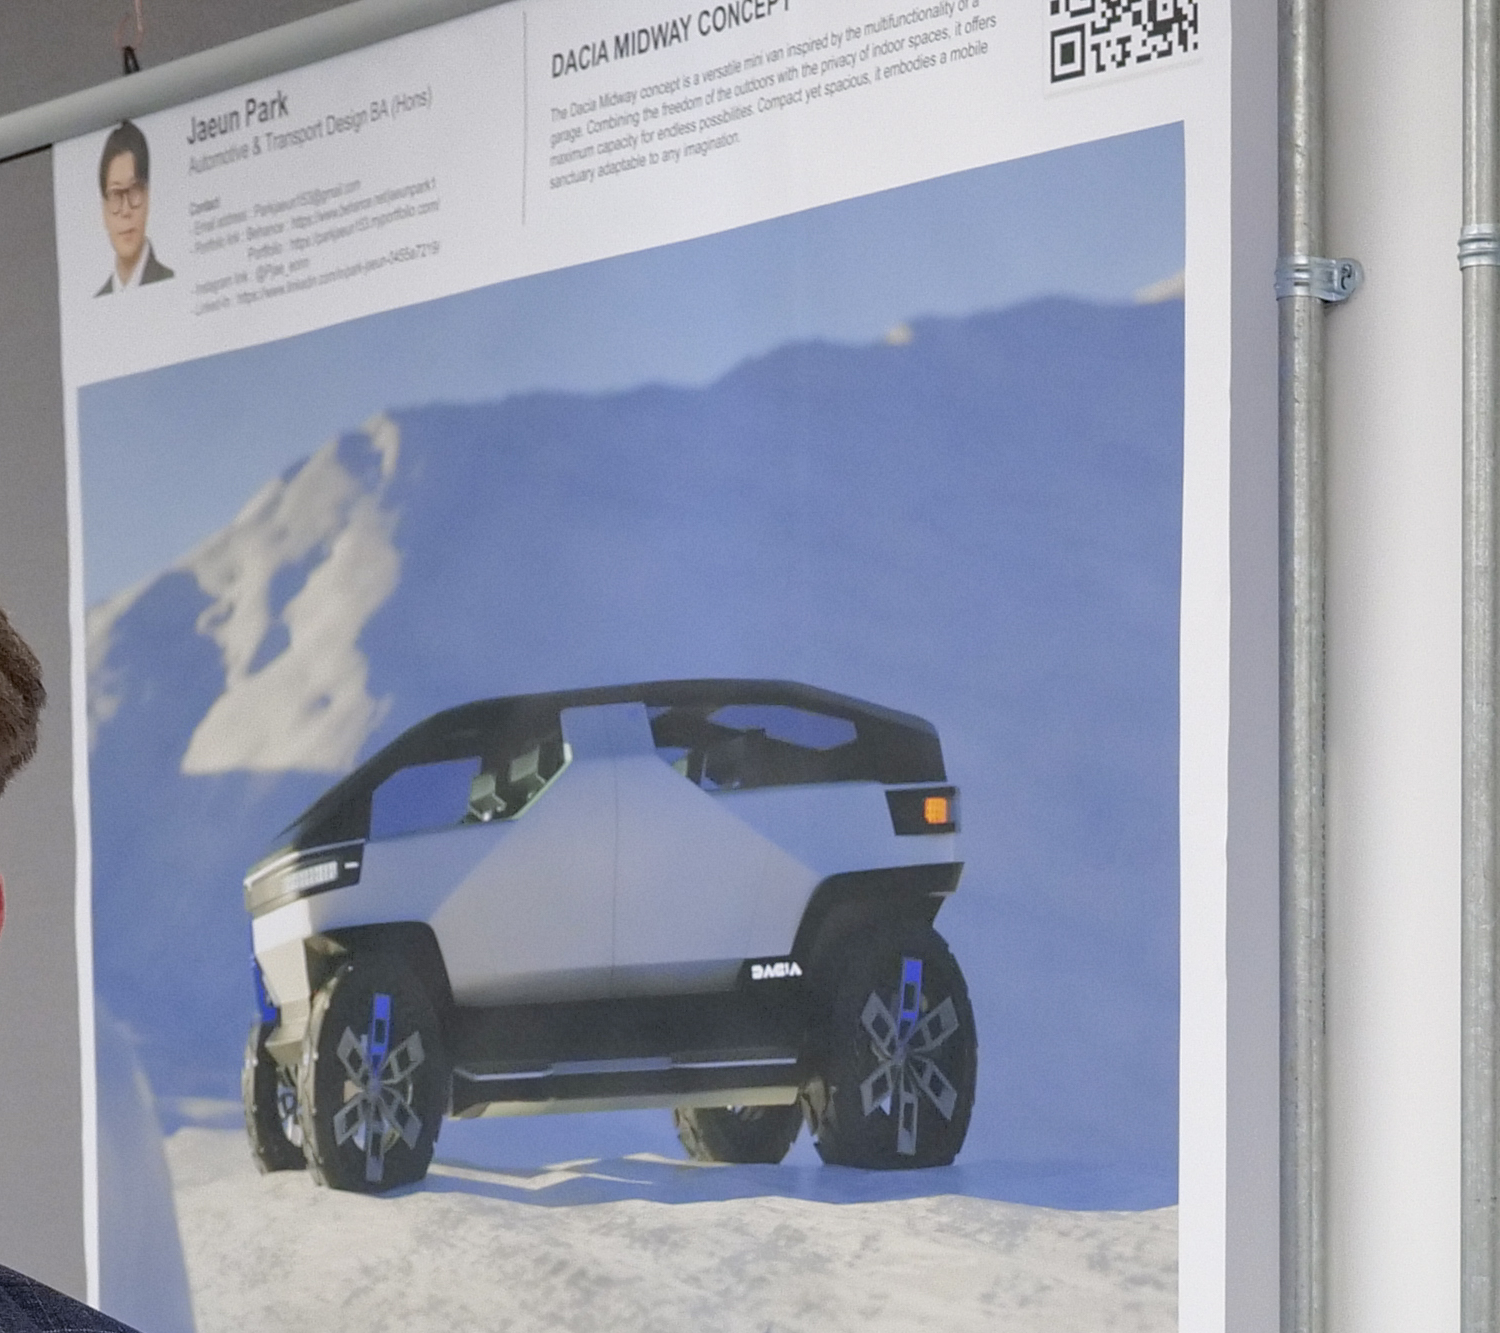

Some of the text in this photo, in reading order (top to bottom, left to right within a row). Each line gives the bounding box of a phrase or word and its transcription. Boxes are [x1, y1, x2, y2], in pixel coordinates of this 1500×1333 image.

[550, 107, 568, 122] The
[570, 100, 597, 117] Dacia
[599, 91, 637, 108] Midway
[640, 77, 680, 99] concept
[683, 76, 691, 88] is
[693, 74, 700, 86] a
[702, 60, 741, 82] versatile
[744, 55, 763, 70] mini
[766, 48, 784, 63] van
[787, 34, 828, 57] inspired
[831, 33, 843, 48] by
[845, 27, 861, 41] the
[864, 2, 955, 35] multifunctionality
[551, 40, 610, 79] DACIA
[613, 14, 692, 61] MIDWAY
[587, 112, 640, 135] Combining
[643, 107, 659, 121] the
[662, 96, 702, 116] freedom
[705, 89, 715, 105] of
[717, 87, 732, 102] the
[734, 74, 775, 97] outdoors
[777, 68, 798, 83] with
[801, 63, 818, 78] the
[821, 52, 857, 76] privacy
[859, 48, 870, 62] of
[872, 39, 905, 57] indoor
[908, 28, 951, 49] spaces,
[955, 24, 962, 36] it
[965, 15, 997, 34] offers
[187, 90, 288, 144] Jaeun Park
[252, 136, 262, 155] &
[266, 121, 323, 151] Transport
[326, 110, 368, 136] Design
[370, 103, 388, 122] BA
[550, 145, 594, 166] maximum
[597, 134, 638, 155] capacity
[640, 130, 655, 144] for
[657, 121, 697, 140] endless
[757, 89, 802, 113] Compact
[805, 84, 822, 104] yet
[824, 72, 871, 97] spacious,
[875, 68, 881, 81] it
[883, 54, 936, 79] embodies
[940, 52, 947, 64] a
[950, 42, 988, 61] mobile
[549, 169, 595, 189] sanctuary
[597, 155, 646, 177] adaptable
[649, 152, 659, 165] to
[662, 148, 681, 162] any
